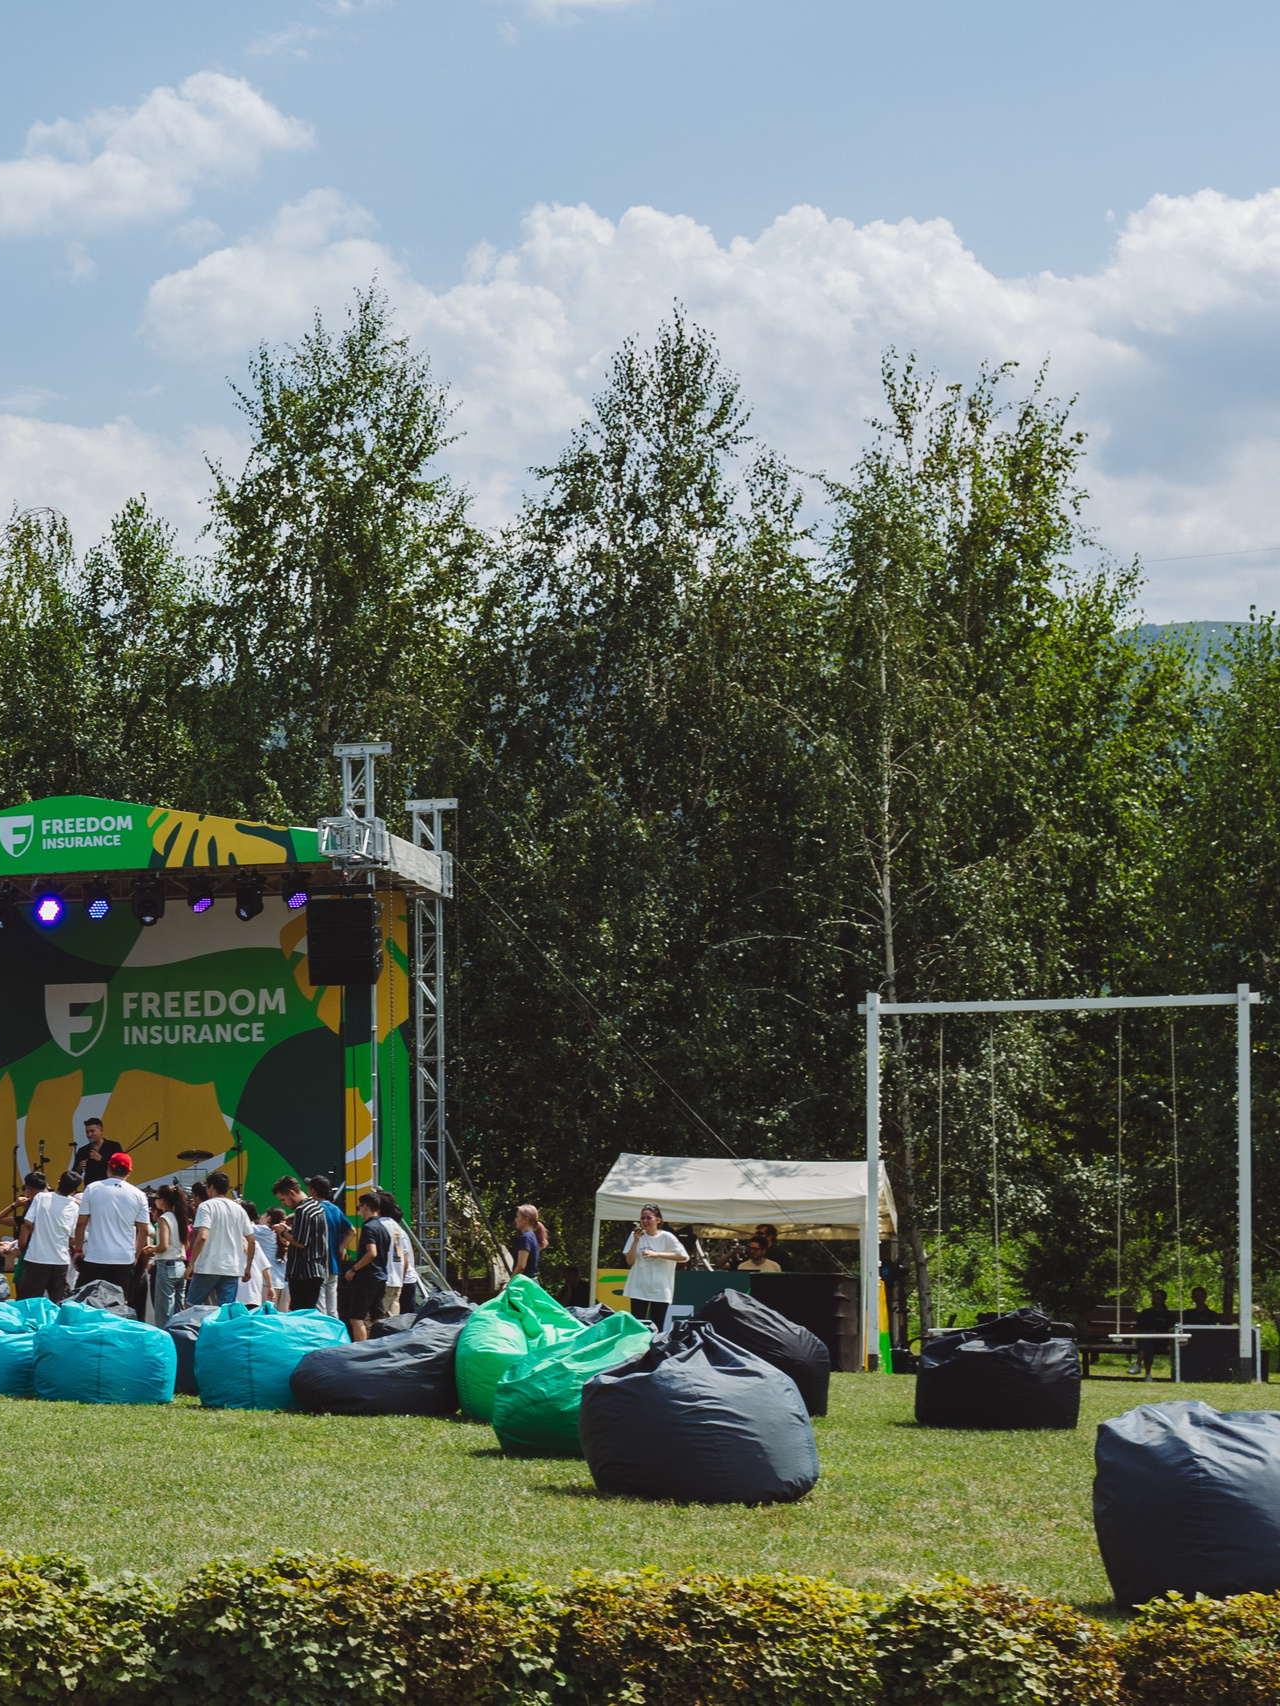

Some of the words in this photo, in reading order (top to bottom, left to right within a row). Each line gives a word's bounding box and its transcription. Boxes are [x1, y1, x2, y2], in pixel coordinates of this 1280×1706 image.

[41, 815, 133, 835] FREEDOM
[42, 834, 121, 850] INSURANCE
[123, 988, 287, 1019] FREEDOM
[123, 1022, 265, 1045] INSURANCE
